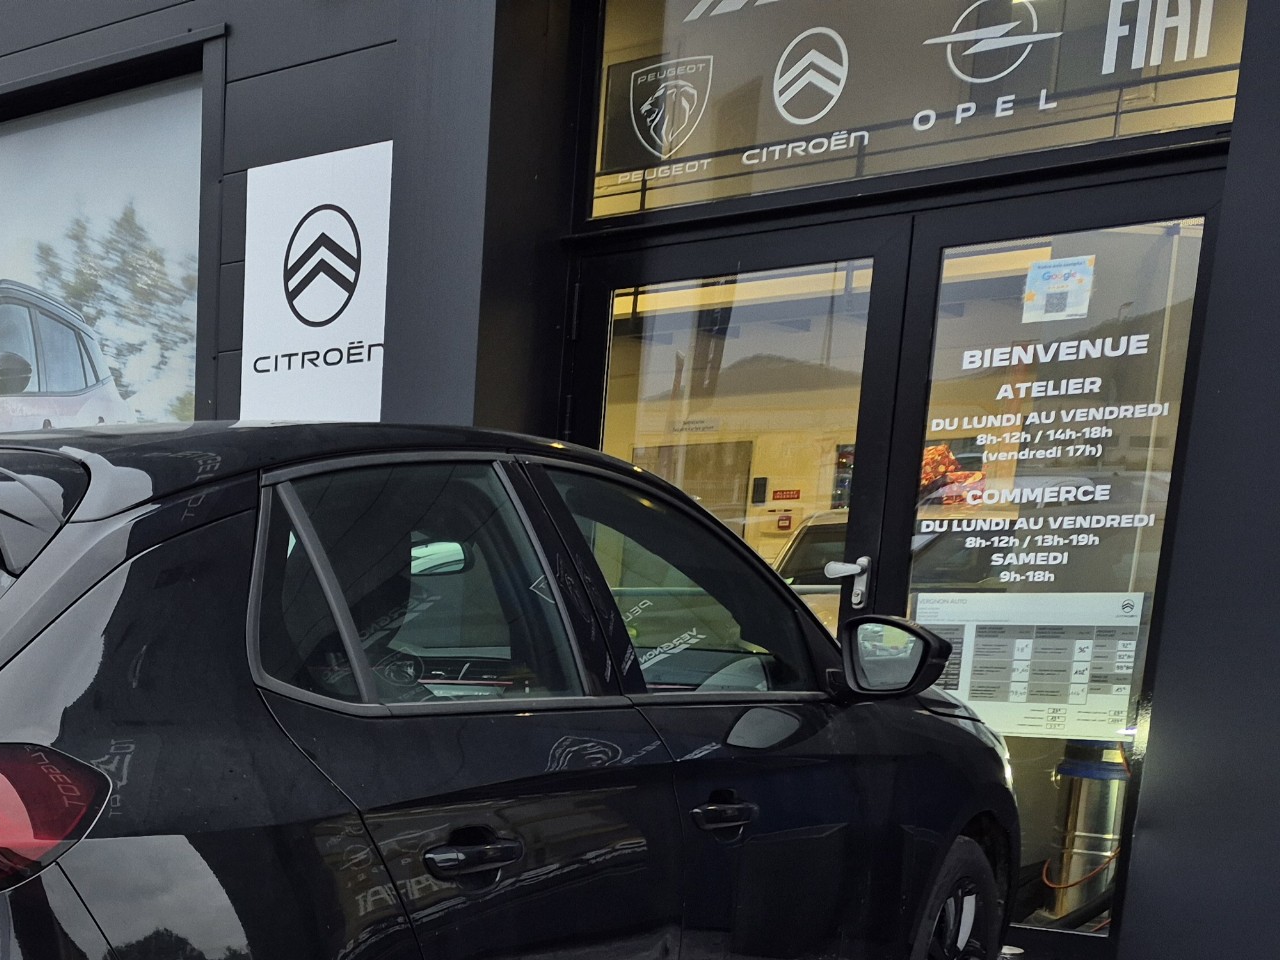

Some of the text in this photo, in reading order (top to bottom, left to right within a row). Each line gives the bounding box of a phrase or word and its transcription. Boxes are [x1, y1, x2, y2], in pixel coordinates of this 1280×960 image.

[637, 63, 705, 85] PEUGEOT
[912, 88, 1058, 132] OPEL
[617, 158, 712, 184] PEUGEOT
[961, 333, 1150, 370] BIENVENUE
[995, 376, 1103, 400] ATELIER
[931, 402, 1170, 432] DU LUNDI AU VENDREDI
[975, 430, 1032, 446] 8h-12h
[1045, 426, 1113, 441] 14h-18h
[982, 444, 1103, 463] (vendredi 17h)
[966, 484, 1112, 505] COMMERCE
[920, 513, 1156, 534] DU LUNDI AU VENDREDI
[964, 535, 1020, 549] 8h-12h
[1033, 533, 1100, 547] 13h-19h
[990, 551, 1069, 567] SAMEDI
[999, 569, 1055, 583] 9h-18h
